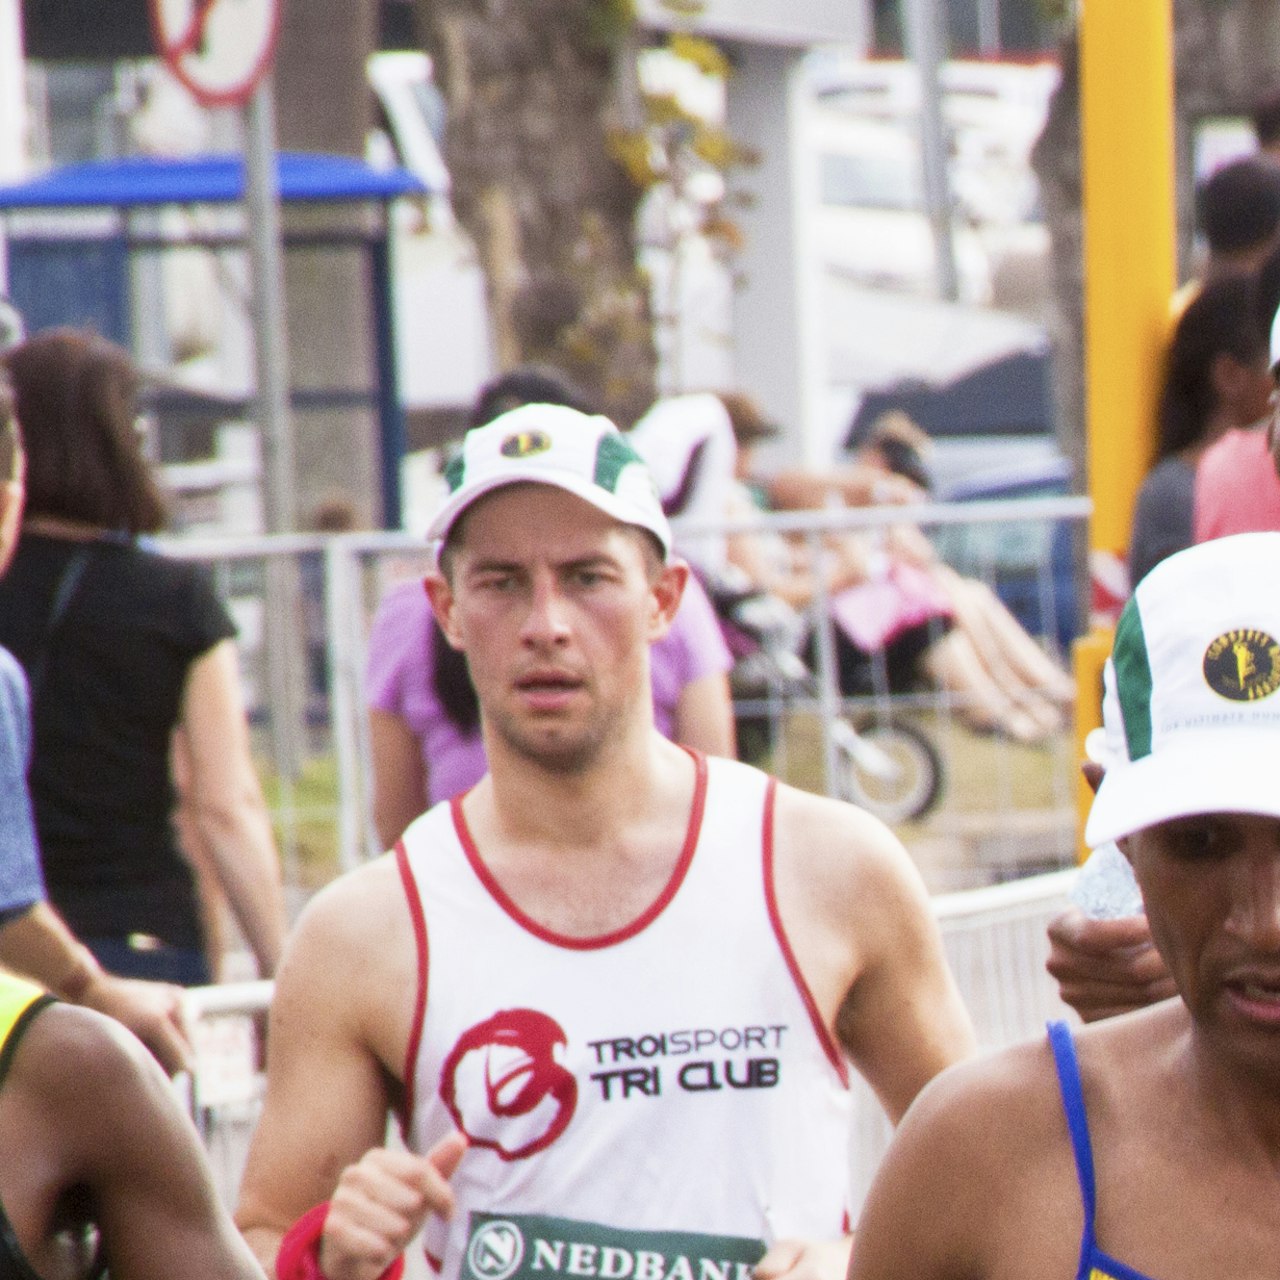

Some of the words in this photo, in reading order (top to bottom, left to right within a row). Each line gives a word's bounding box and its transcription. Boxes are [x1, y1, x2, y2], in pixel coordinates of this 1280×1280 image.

[587, 1025, 789, 1065] TROISPORT
[589, 1066, 660, 1101] TRI
[677, 1058, 780, 1092] CLUB
